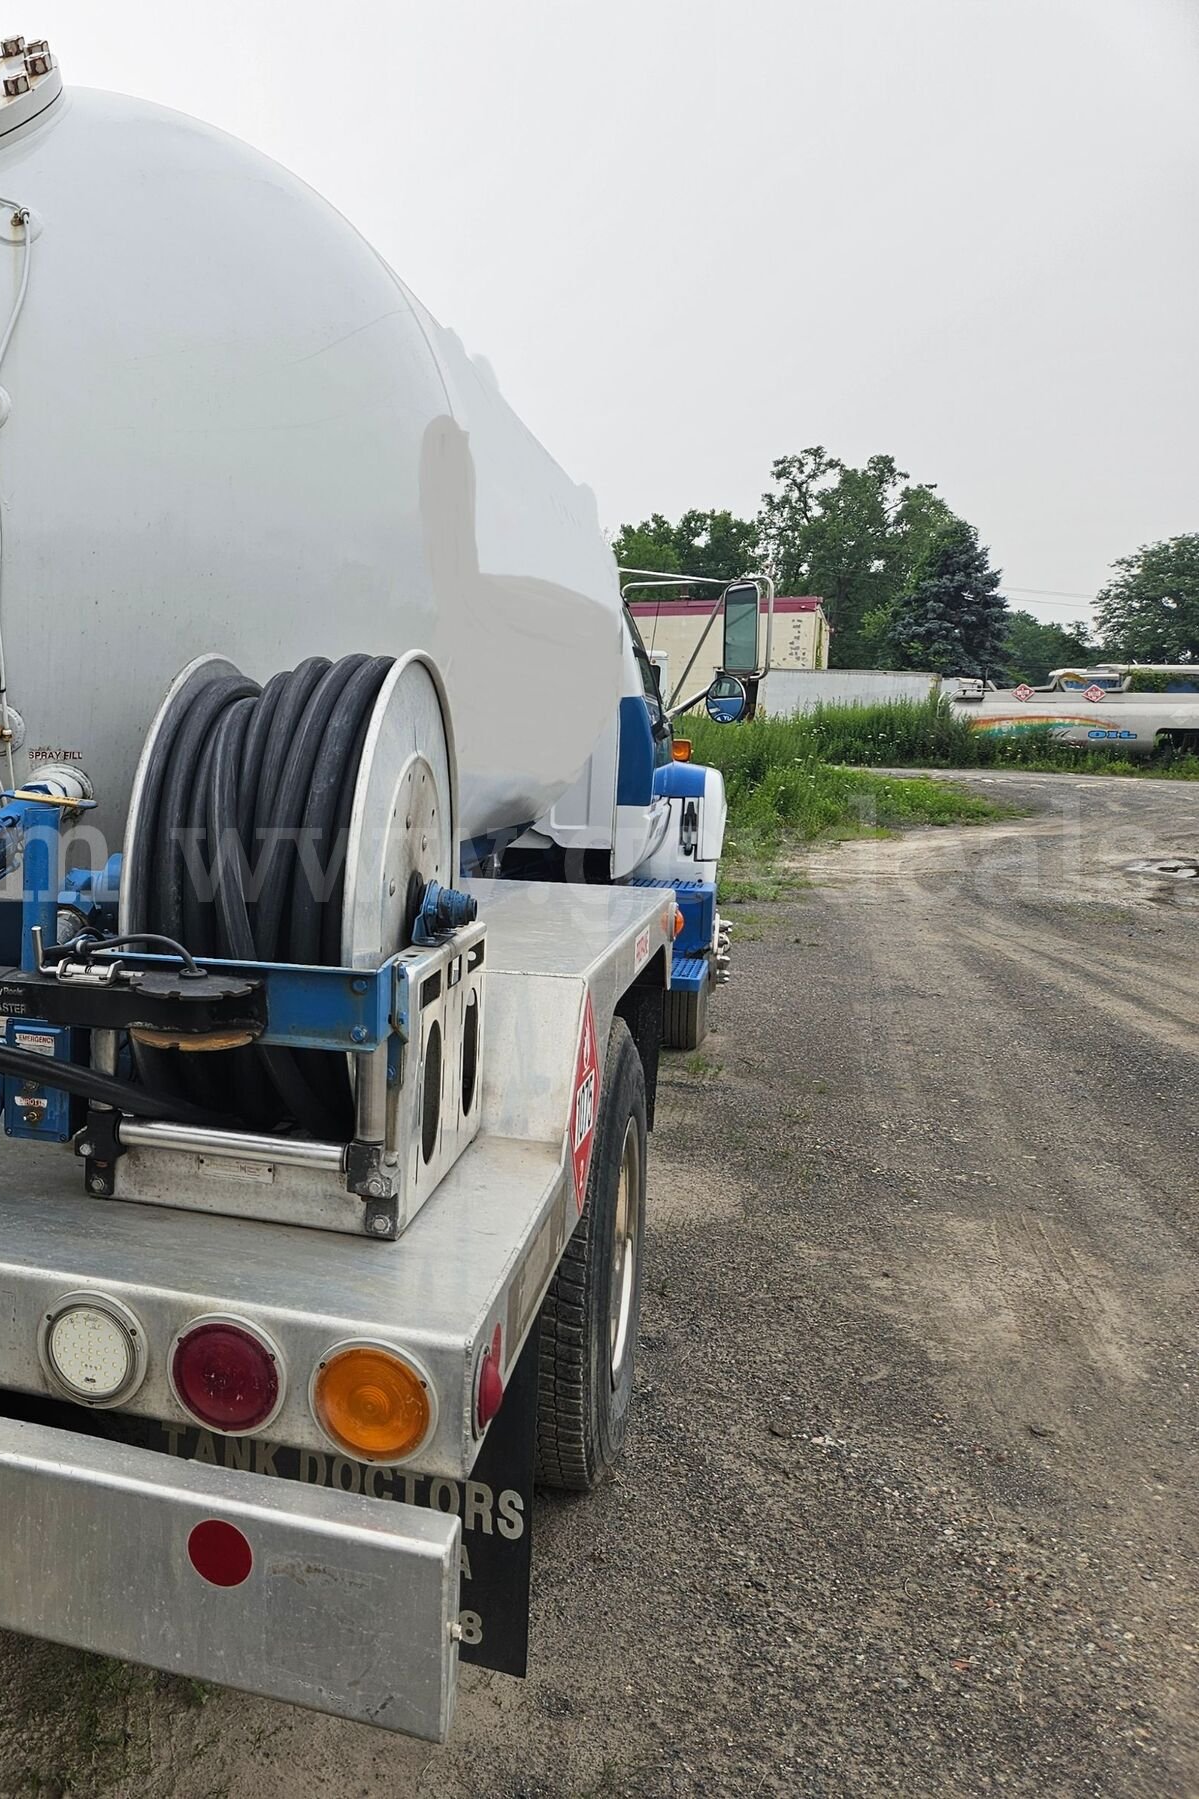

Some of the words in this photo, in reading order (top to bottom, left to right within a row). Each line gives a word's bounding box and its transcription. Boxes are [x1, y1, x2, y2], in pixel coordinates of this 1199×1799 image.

[1087, 730, 1138, 740] OIL
[28, 751, 62, 761] SPRAY
[63, 751, 83, 760] FILL
[18, 1034, 54, 1044] EMERGENCY
[161, 1424, 281, 1478] TANK
[300, 1449, 525, 1540] DOCTORS
